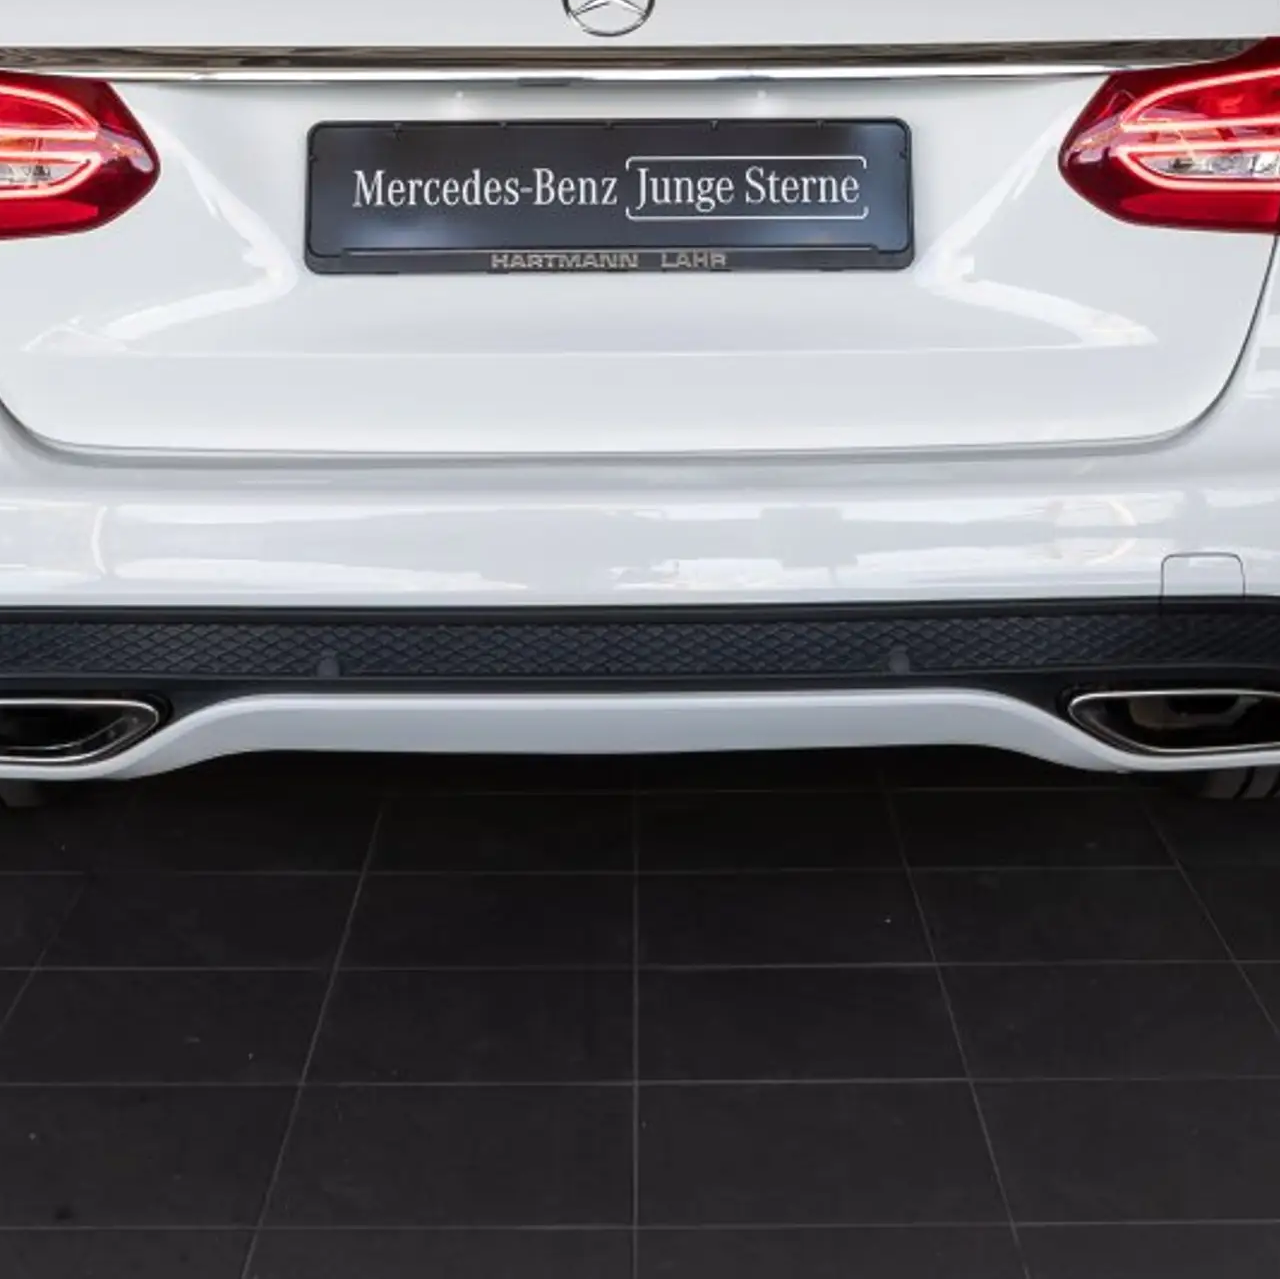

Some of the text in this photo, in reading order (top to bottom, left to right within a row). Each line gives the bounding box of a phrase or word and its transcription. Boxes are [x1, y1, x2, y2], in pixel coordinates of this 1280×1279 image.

[352, 166, 860, 213] Mercedes-Benz Junge Sterne
[490, 251, 727, 270] HARTMANN LAHR
